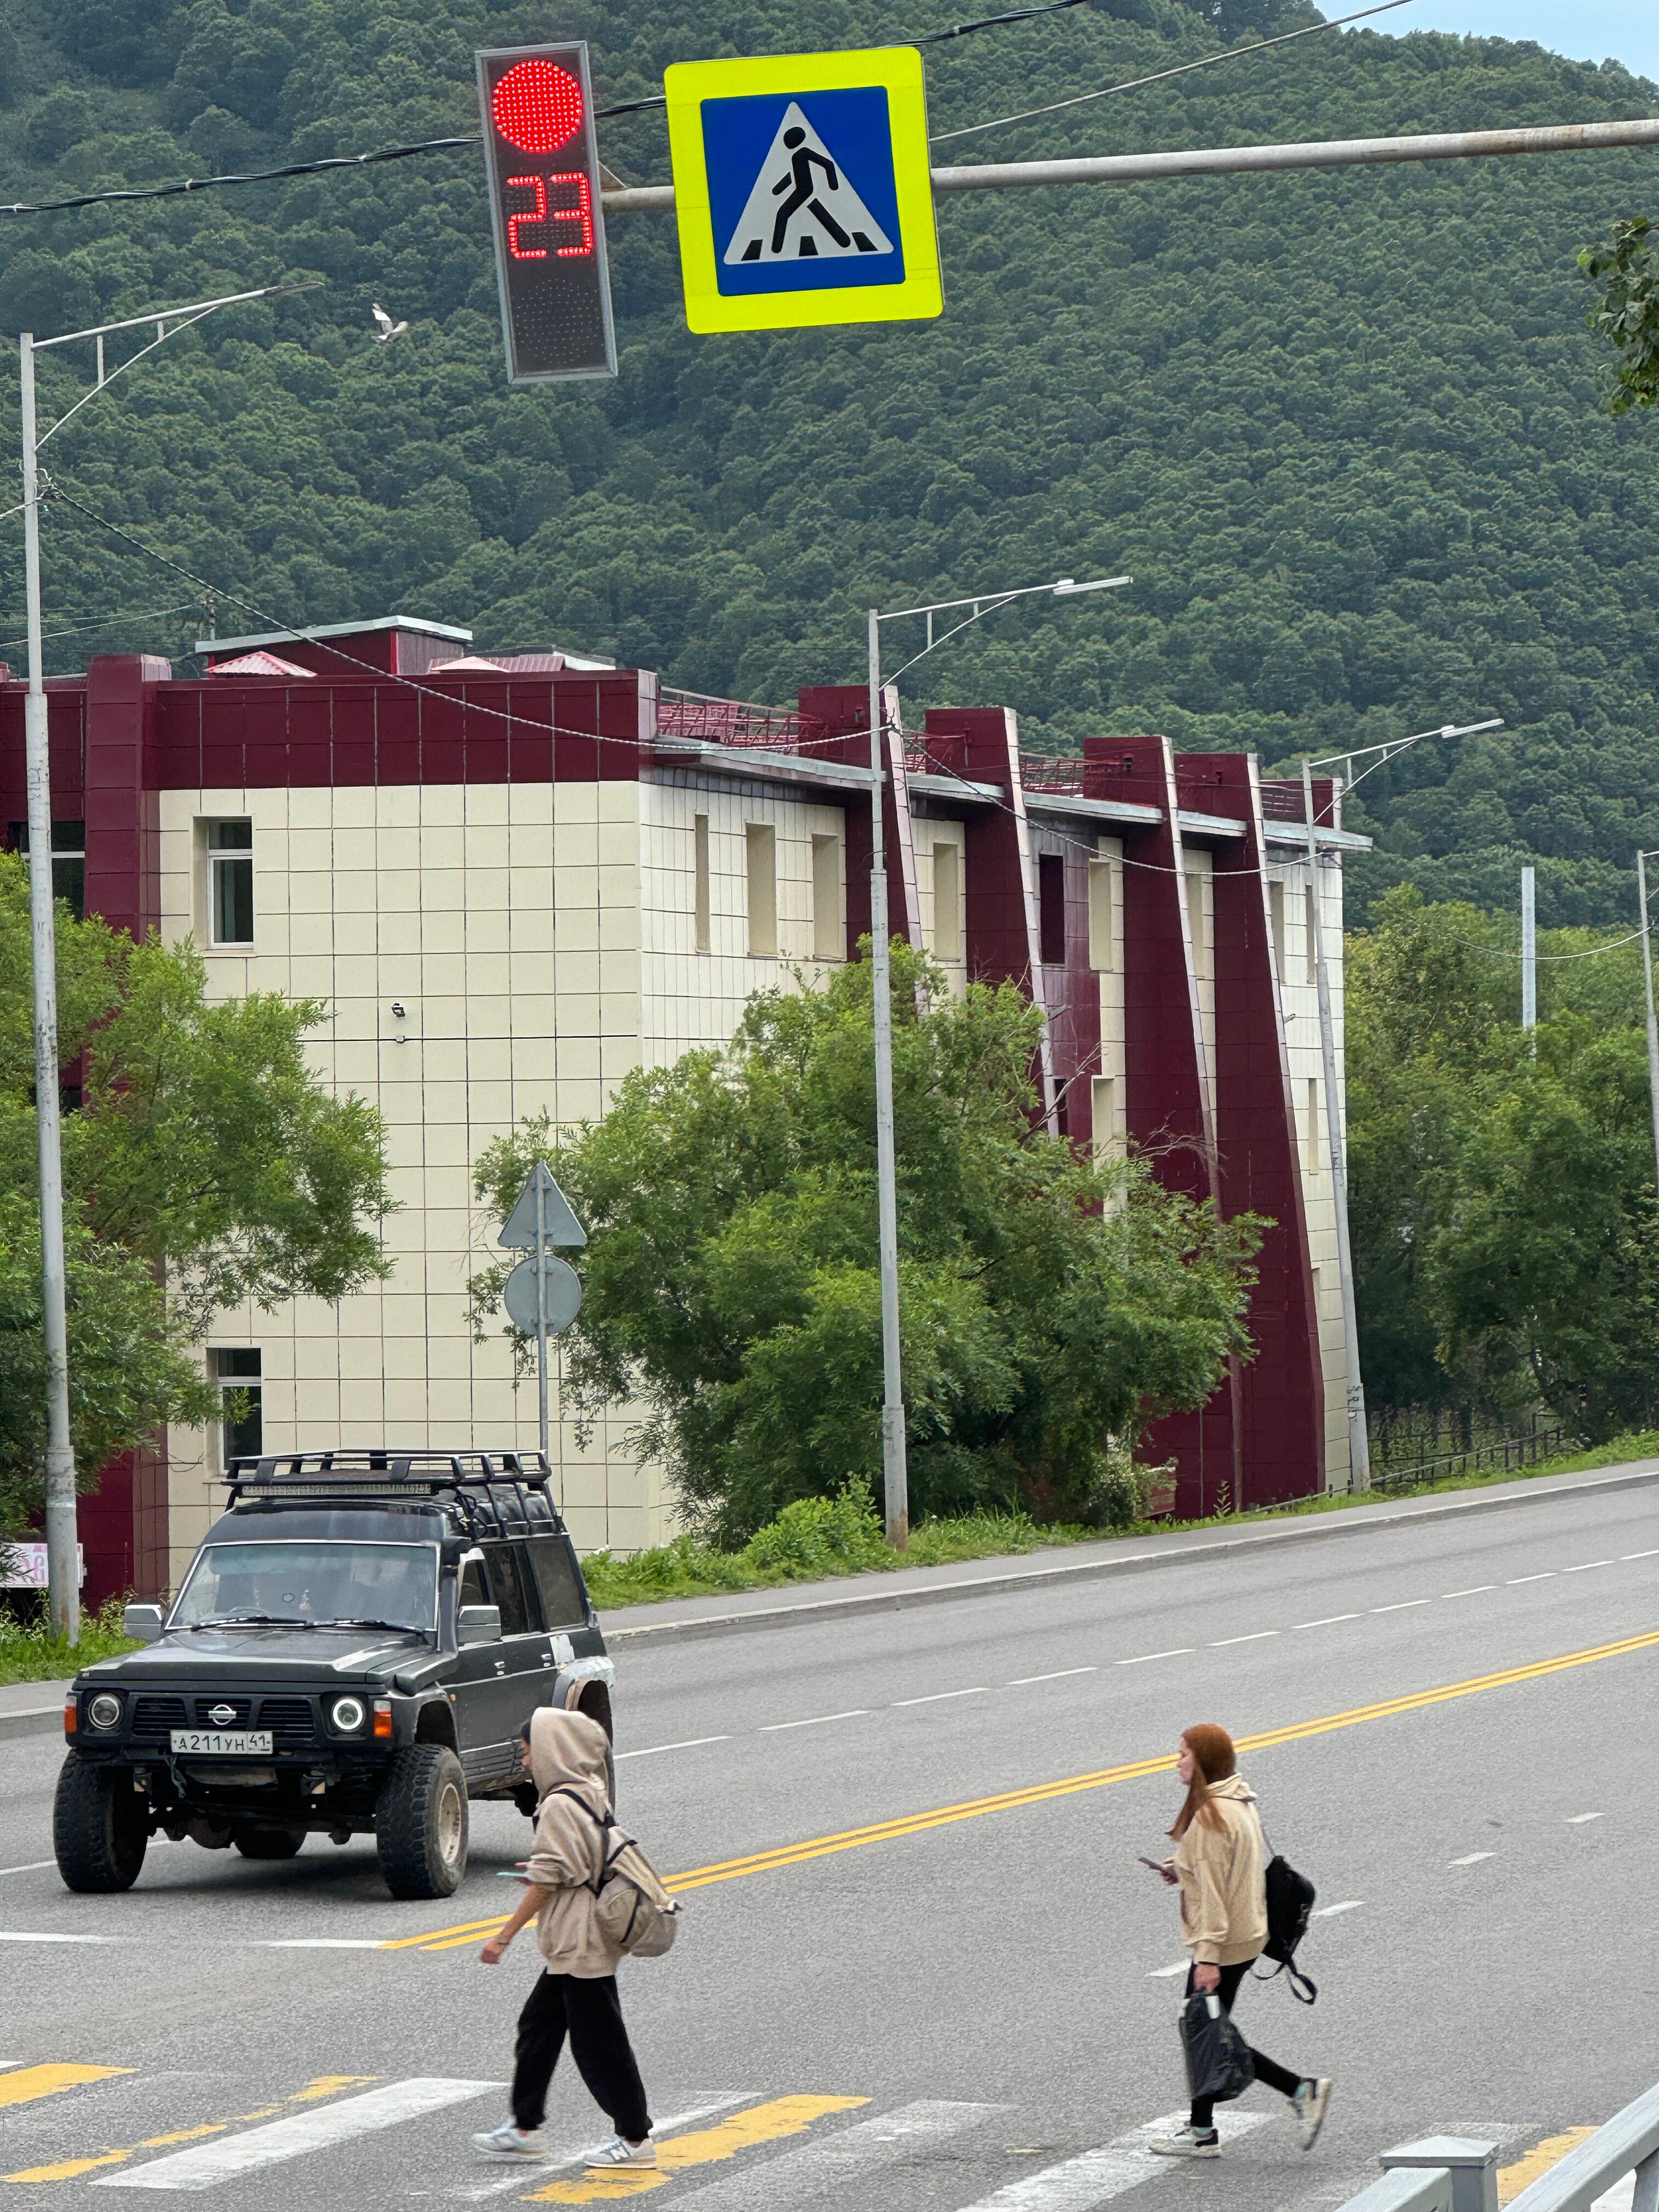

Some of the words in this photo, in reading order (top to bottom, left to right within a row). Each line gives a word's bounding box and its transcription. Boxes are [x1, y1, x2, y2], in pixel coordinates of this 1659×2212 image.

[506, 172, 594, 259] 23
[250, 1734, 266, 1747] 41
[610, 2146, 628, 2160] N
